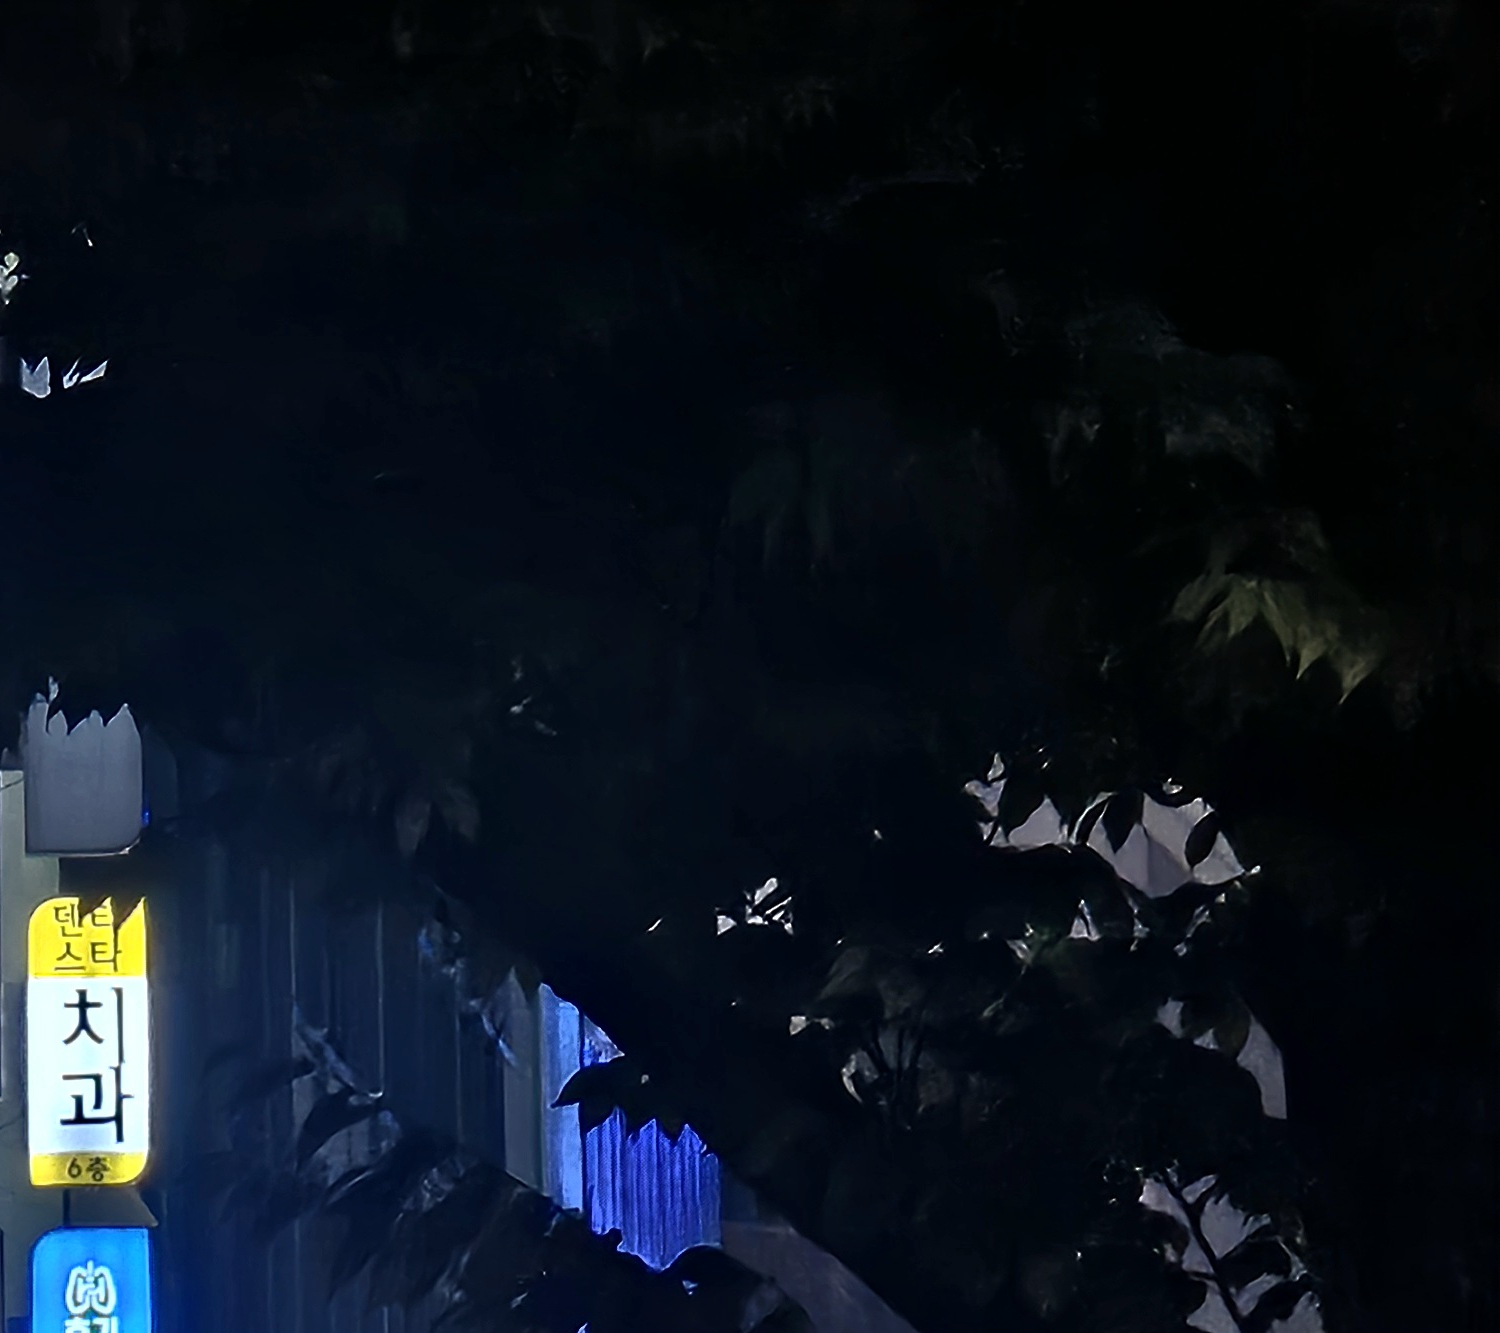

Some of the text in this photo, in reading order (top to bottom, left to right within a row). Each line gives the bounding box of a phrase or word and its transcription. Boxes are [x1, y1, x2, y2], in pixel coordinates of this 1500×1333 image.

[54, 942, 123, 972] 스타
[59, 987, 135, 1143] 치과
[68, 1157, 110, 1182] 6층
